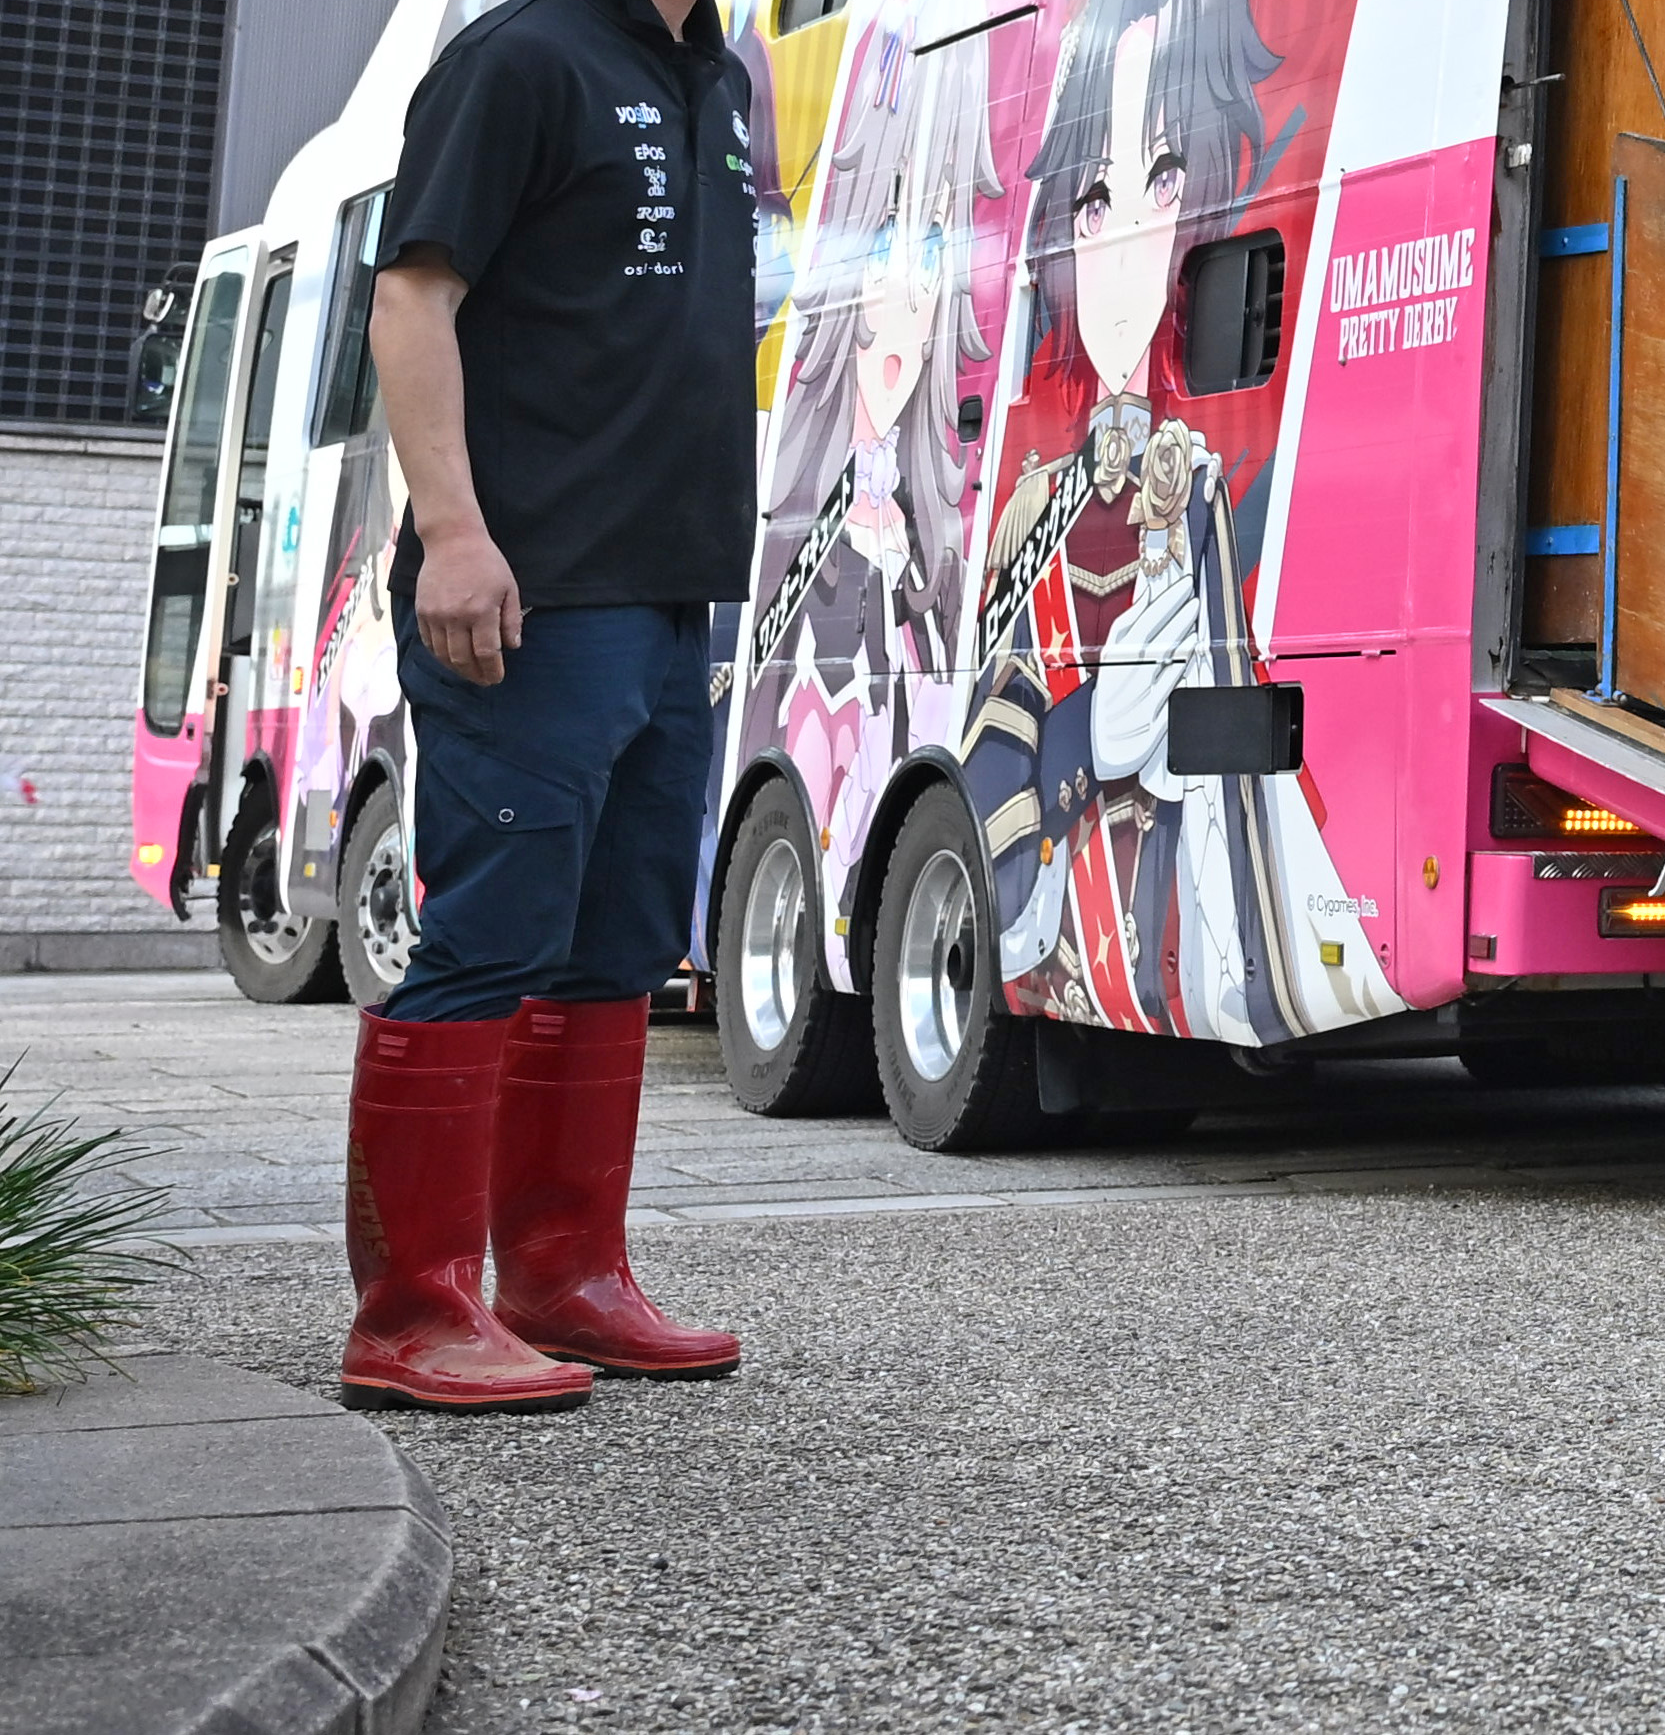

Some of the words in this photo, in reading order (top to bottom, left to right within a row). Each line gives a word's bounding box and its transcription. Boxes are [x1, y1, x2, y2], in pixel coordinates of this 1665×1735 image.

[615, 102, 662, 129] yogibo
[634, 142, 666, 161] EPOS
[1330, 228, 1476, 313] UMAMUSUME
[1338, 307, 1401, 361] PRETTY
[1402, 296, 1459, 350] DERBY
[759, 472, 852, 660] ワンダーアキュート
[985, 455, 1089, 654] ローズキングダム
